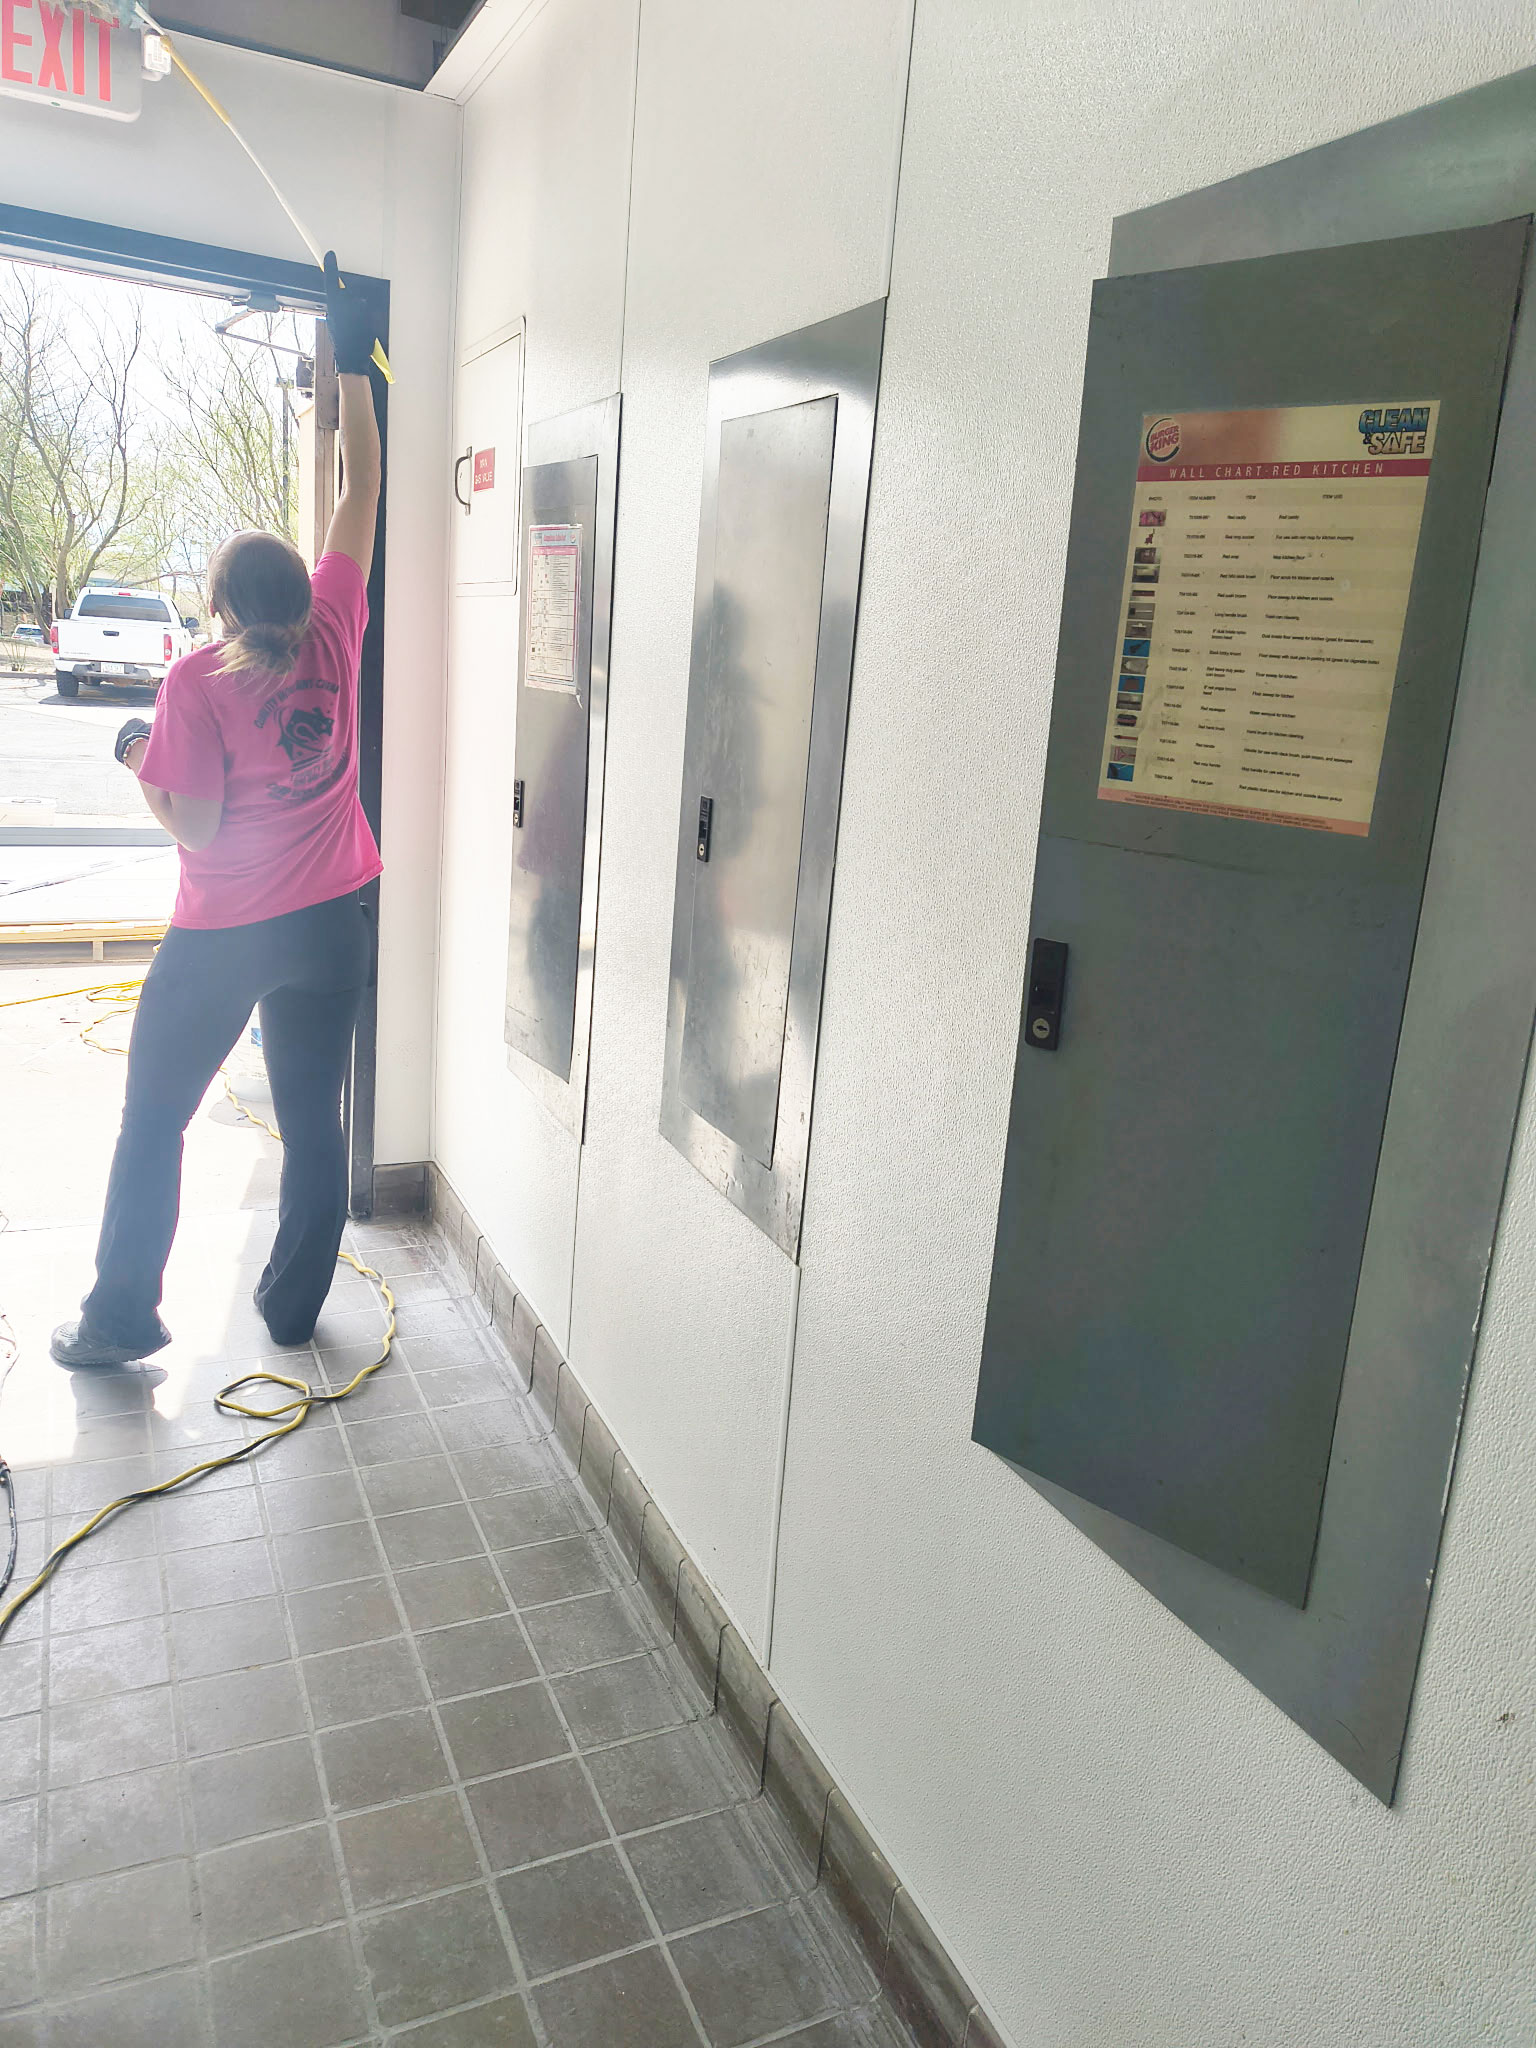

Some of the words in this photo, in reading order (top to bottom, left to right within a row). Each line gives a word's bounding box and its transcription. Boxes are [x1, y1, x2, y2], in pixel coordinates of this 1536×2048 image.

[2, 0, 120, 102] EXIT
[1359, 407, 1430, 434] CLEAN
[1149, 434, 1180, 453] KING
[1150, 425, 1180, 443] BURGER
[1368, 431, 1427, 455] SAFE
[1169, 467, 1205, 480] WALL
[1312, 462, 1384, 476] KITCHEN
